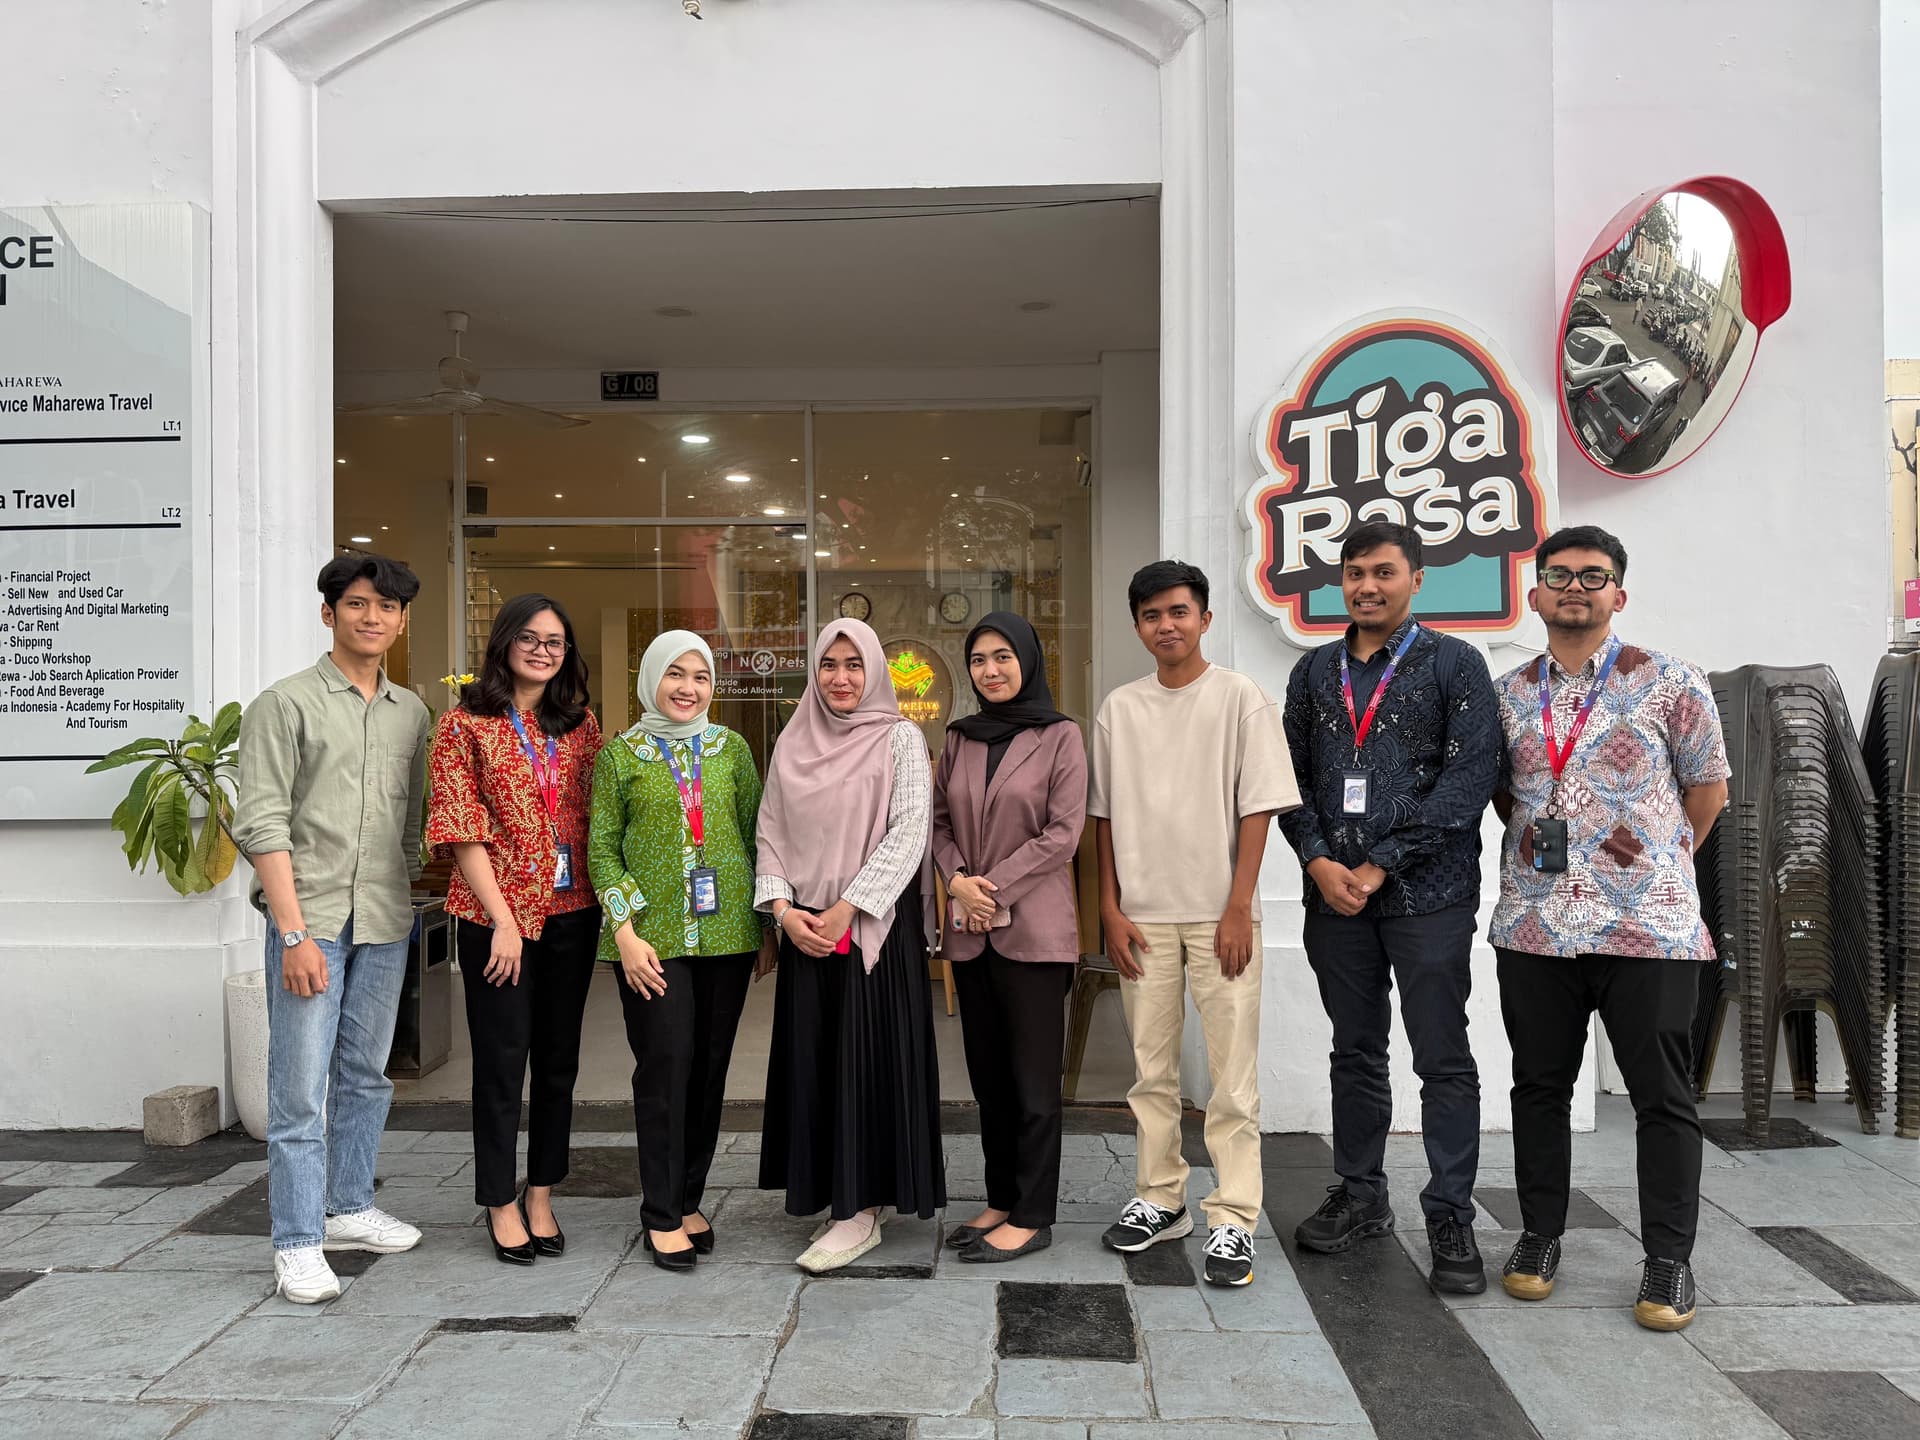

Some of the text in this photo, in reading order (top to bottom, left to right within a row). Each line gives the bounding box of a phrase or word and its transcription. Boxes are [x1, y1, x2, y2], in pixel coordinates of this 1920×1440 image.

[605, 376, 619, 392] G
[634, 376, 655, 392] 08
[33, 394, 105, 412] Maharewa
[109, 393, 152, 411] Travel
[163, 421, 181, 431] LT.1
[1287, 385, 1508, 497] Tiga
[12, 489, 75, 509] Travel
[162, 507, 181, 518] LT.2
[10, 571, 54, 583] Financial
[57, 570, 91, 584] Project
[8, 587, 25, 600] Sell
[28, 587, 49, 600] New
[58, 587, 76, 599] and
[79, 586, 103, 599] Used
[106, 586, 124, 599] Car
[8, 604, 62, 618] Advertising
[65, 603, 84, 616] And
[87, 603, 118, 618] Digital
[121, 603, 169, 616] Marketing
[17, 620, 34, 633] Car
[37, 620, 59, 632] Rent
[10, 636, 52, 650] Shipping
[14, 653, 39, 665] Duco
[42, 652, 91, 666] Workshop
[780, 656, 806, 668] Pets
[0, 671, 20, 682] ewa
[29, 670, 47, 681] Job
[49, 669, 83, 681] Search
[85, 668, 134, 683] Aplication
[138, 668, 179, 680] Provider
[11, 685, 34, 697] Food
[37, 685, 56, 697] And
[59, 685, 105, 699] Beverage
[716, 686, 783, 695] Or Food Allowed
[11, 701, 58, 713] Indonesia
[66, 700, 111, 714] Academy
[114, 699, 130, 711] For
[133, 699, 185, 713] Hospitality
[66, 717, 128, 729] And Tourism
